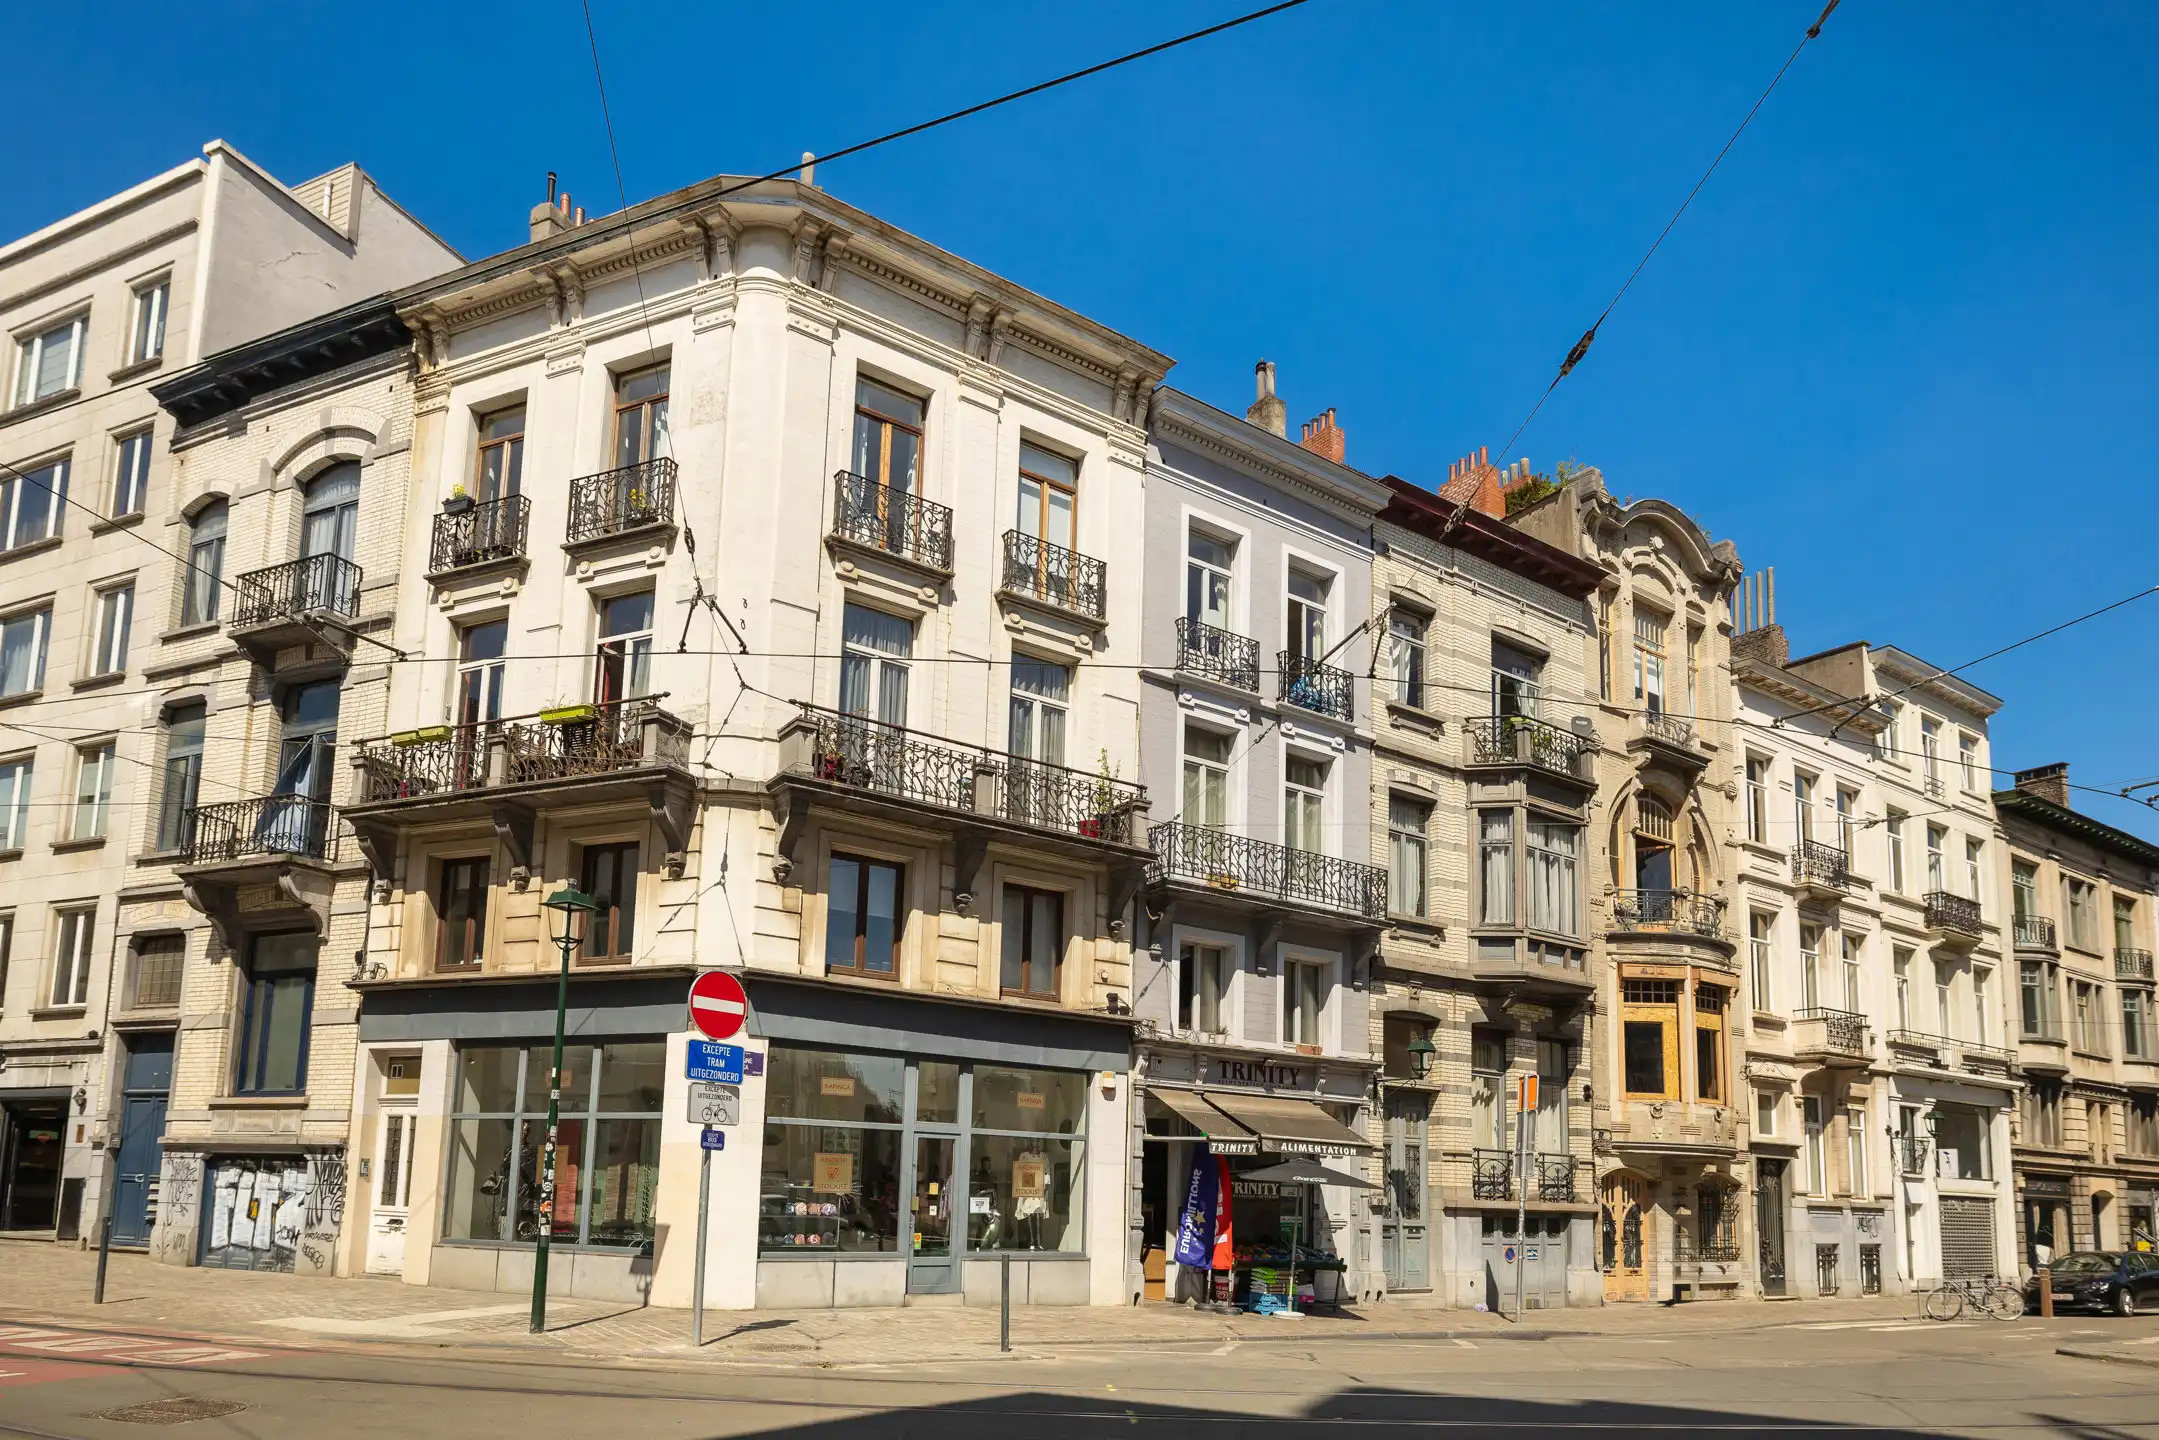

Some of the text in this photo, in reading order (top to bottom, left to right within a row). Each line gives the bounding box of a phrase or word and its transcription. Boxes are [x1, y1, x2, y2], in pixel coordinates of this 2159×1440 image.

[707, 1057, 725, 1068] TRAM
[690, 1068, 740, 1082] UITGEZONDERD
[1217, 1060, 1301, 1085] TRINITY
[697, 1092, 733, 1102] UITGEZONDERD
[1211, 1142, 1254, 1153] TRINITY
[1281, 1142, 1357, 1156] ALIMENTATION
[1230, 1182, 1279, 1195] RINITY
